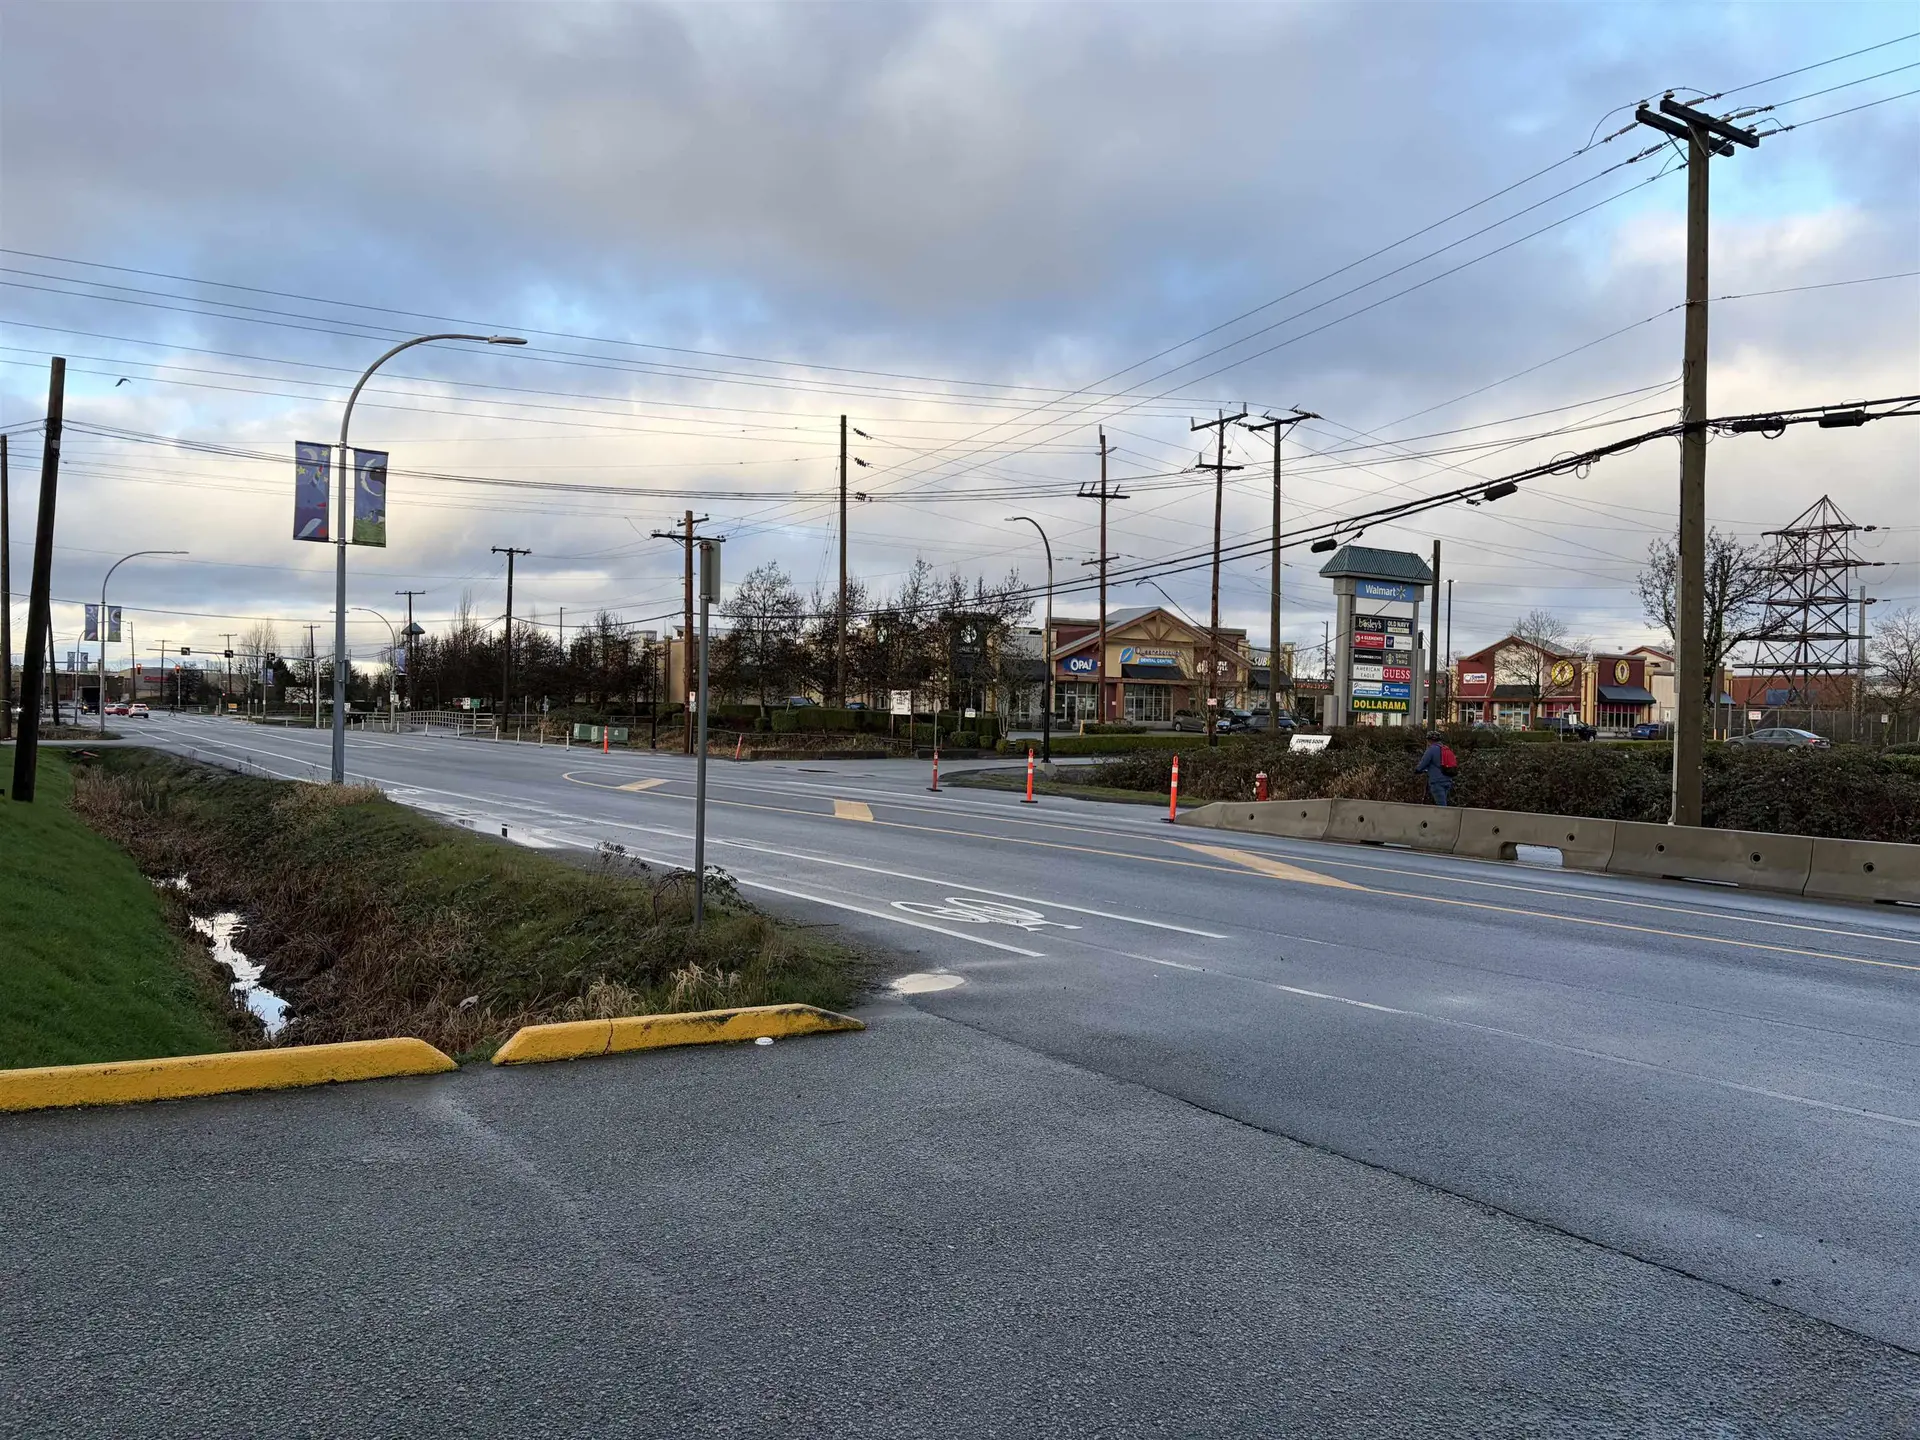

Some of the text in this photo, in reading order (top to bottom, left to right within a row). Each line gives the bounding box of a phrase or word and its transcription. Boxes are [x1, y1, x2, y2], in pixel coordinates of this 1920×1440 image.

[1365, 584, 1396, 597] Walmart
[1070, 658, 1092, 671] OPA!
[1254, 656, 1271, 666] SUB
[1383, 668, 1411, 679] GUESS
[1353, 699, 1407, 710] DOLLARAMA
